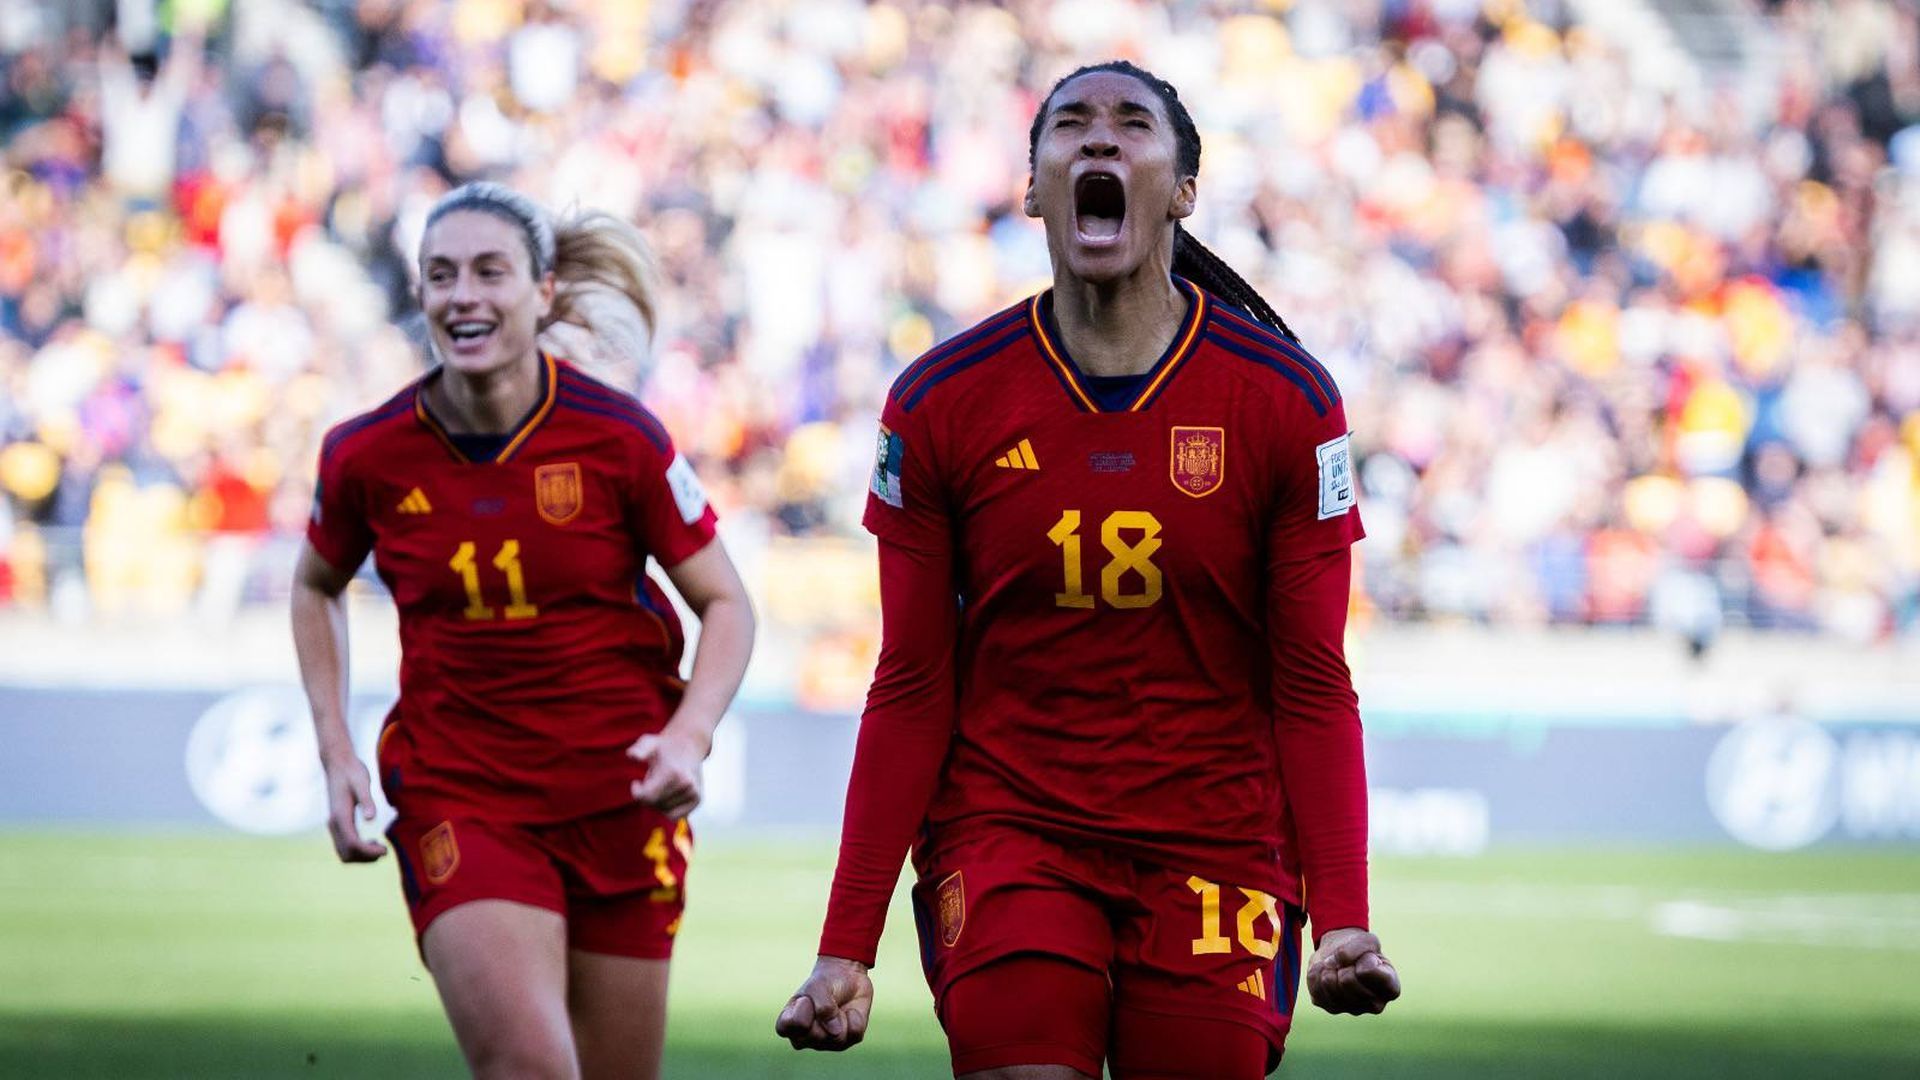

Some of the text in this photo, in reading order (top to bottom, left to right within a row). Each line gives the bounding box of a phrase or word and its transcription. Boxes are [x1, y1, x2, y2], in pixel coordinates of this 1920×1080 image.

[449, 539, 538, 620] 11
[1046, 509, 1162, 609] 18
[1186, 875, 1281, 960] 18
